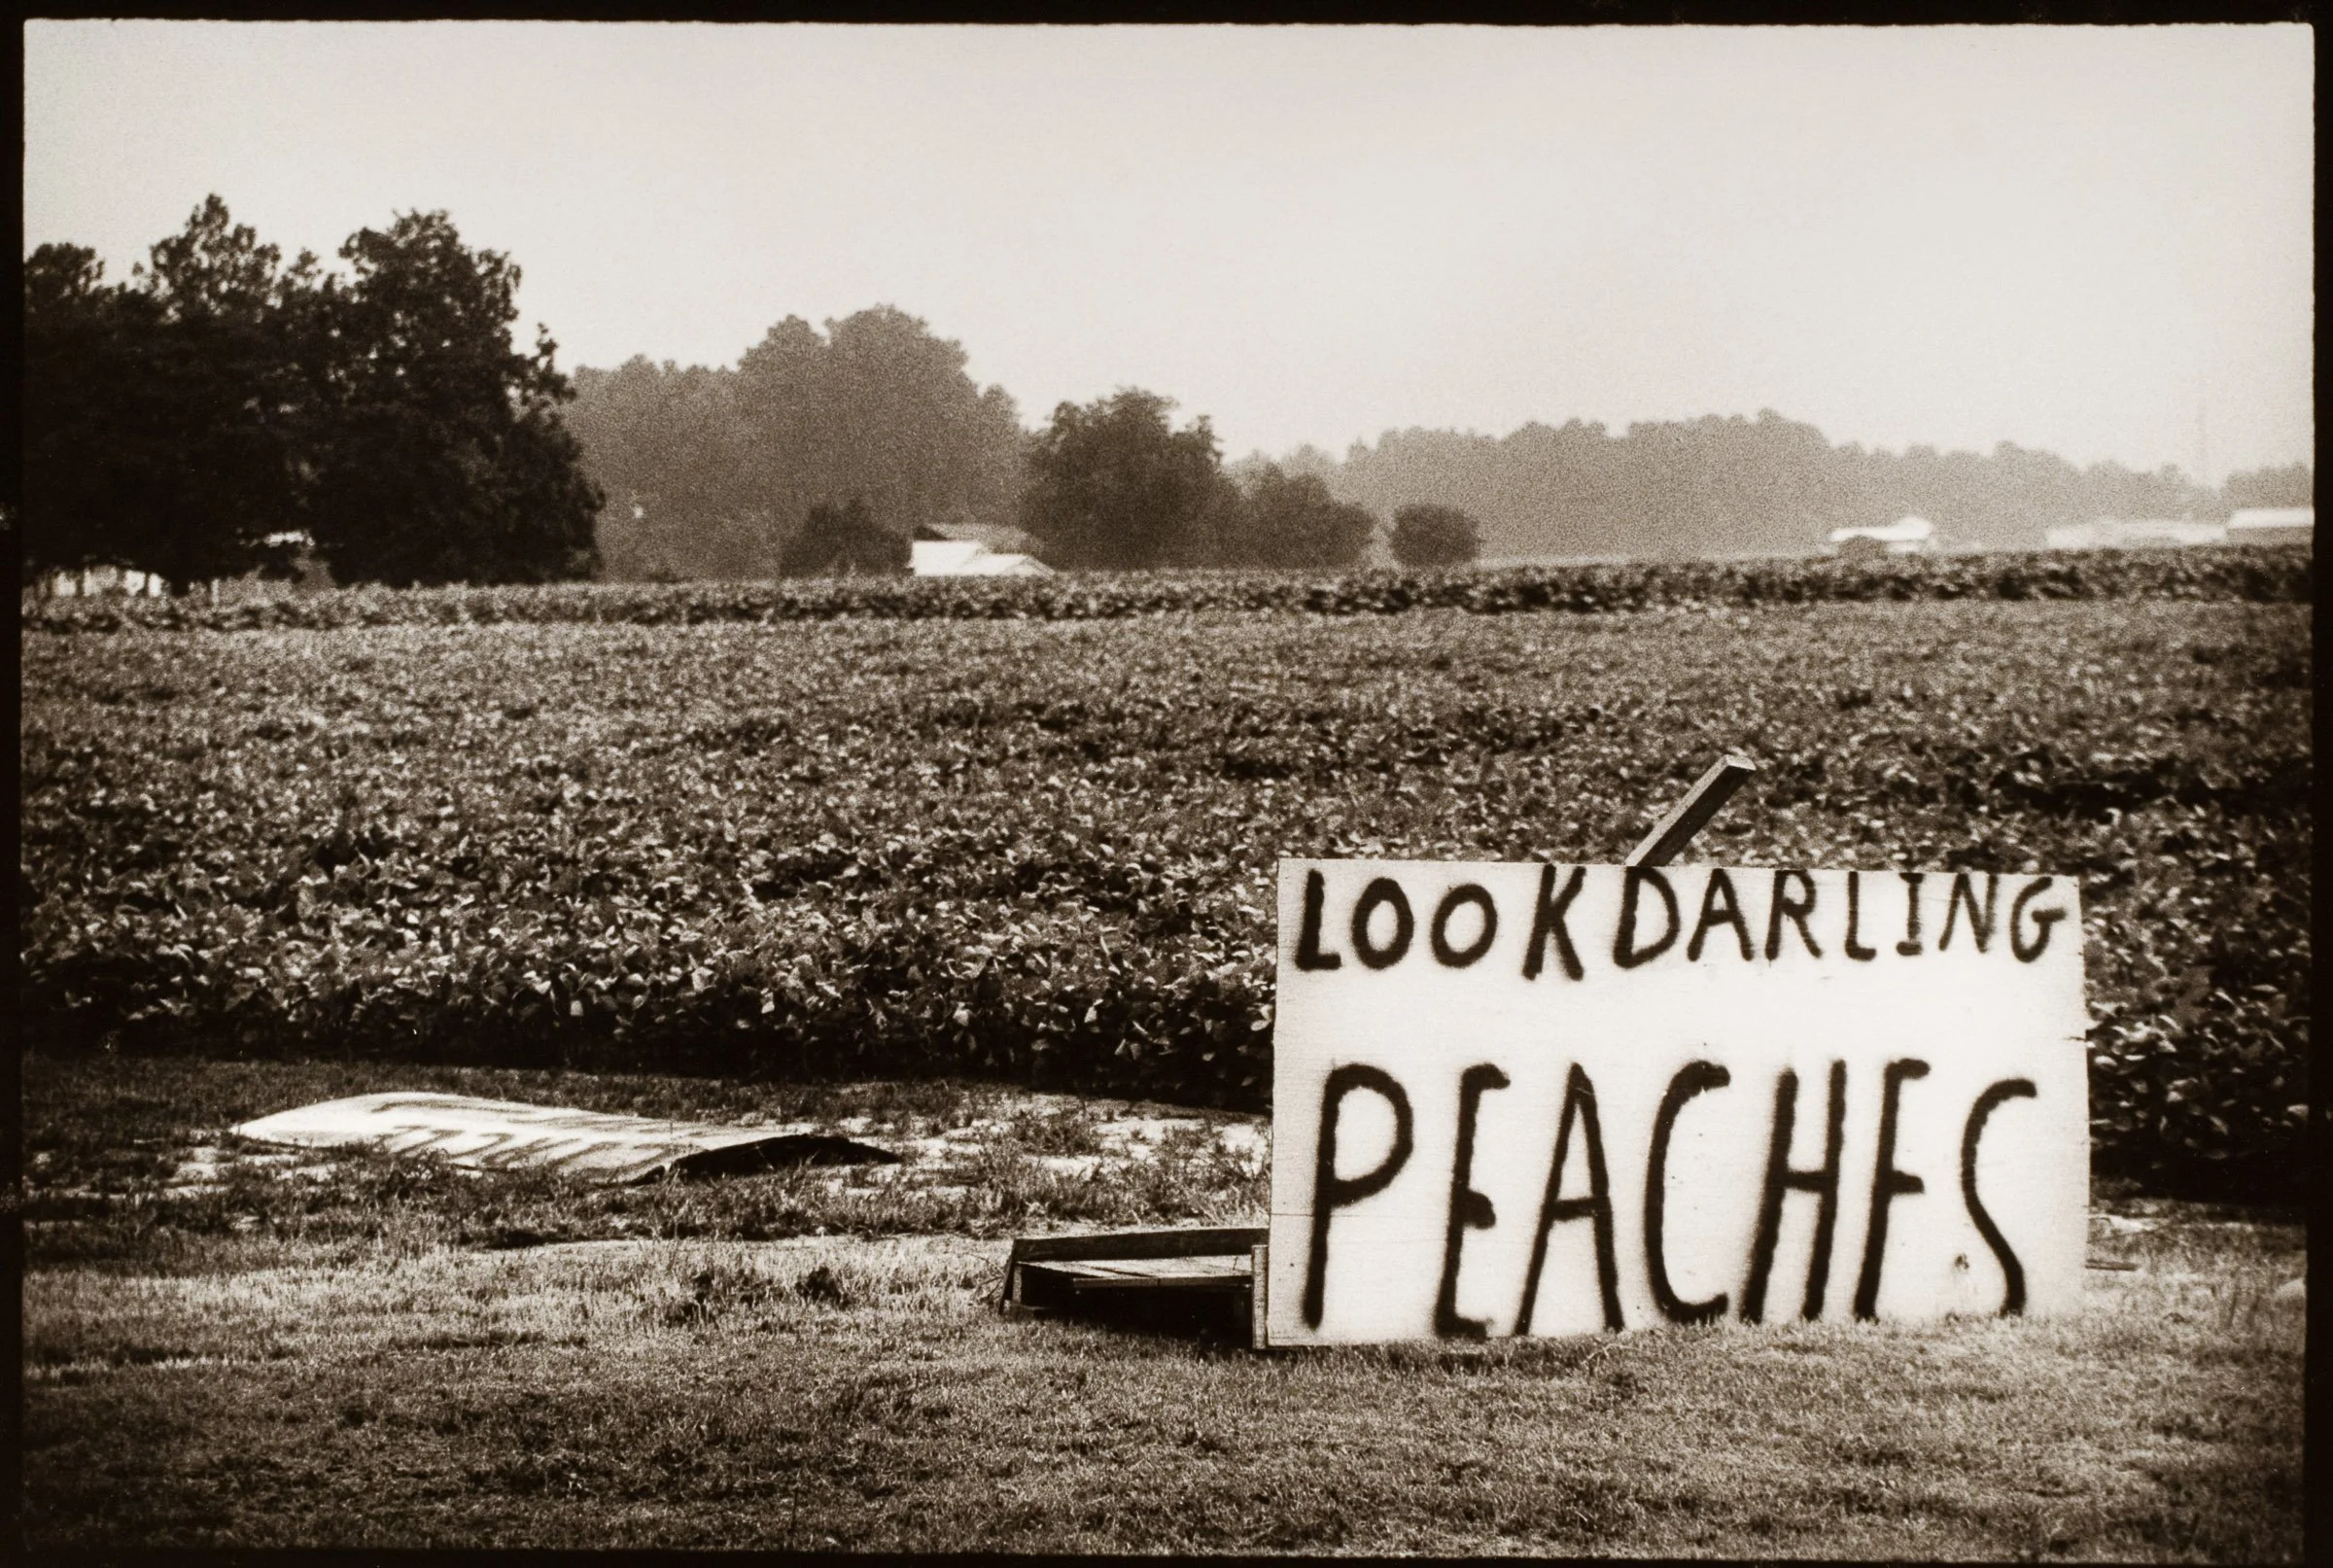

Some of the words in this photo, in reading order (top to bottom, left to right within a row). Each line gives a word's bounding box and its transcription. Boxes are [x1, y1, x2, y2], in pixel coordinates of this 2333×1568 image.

[1296, 862, 1587, 980] LOOK
[1612, 865, 2068, 969] DARLING
[1302, 1059, 2038, 1339] PEACHES
